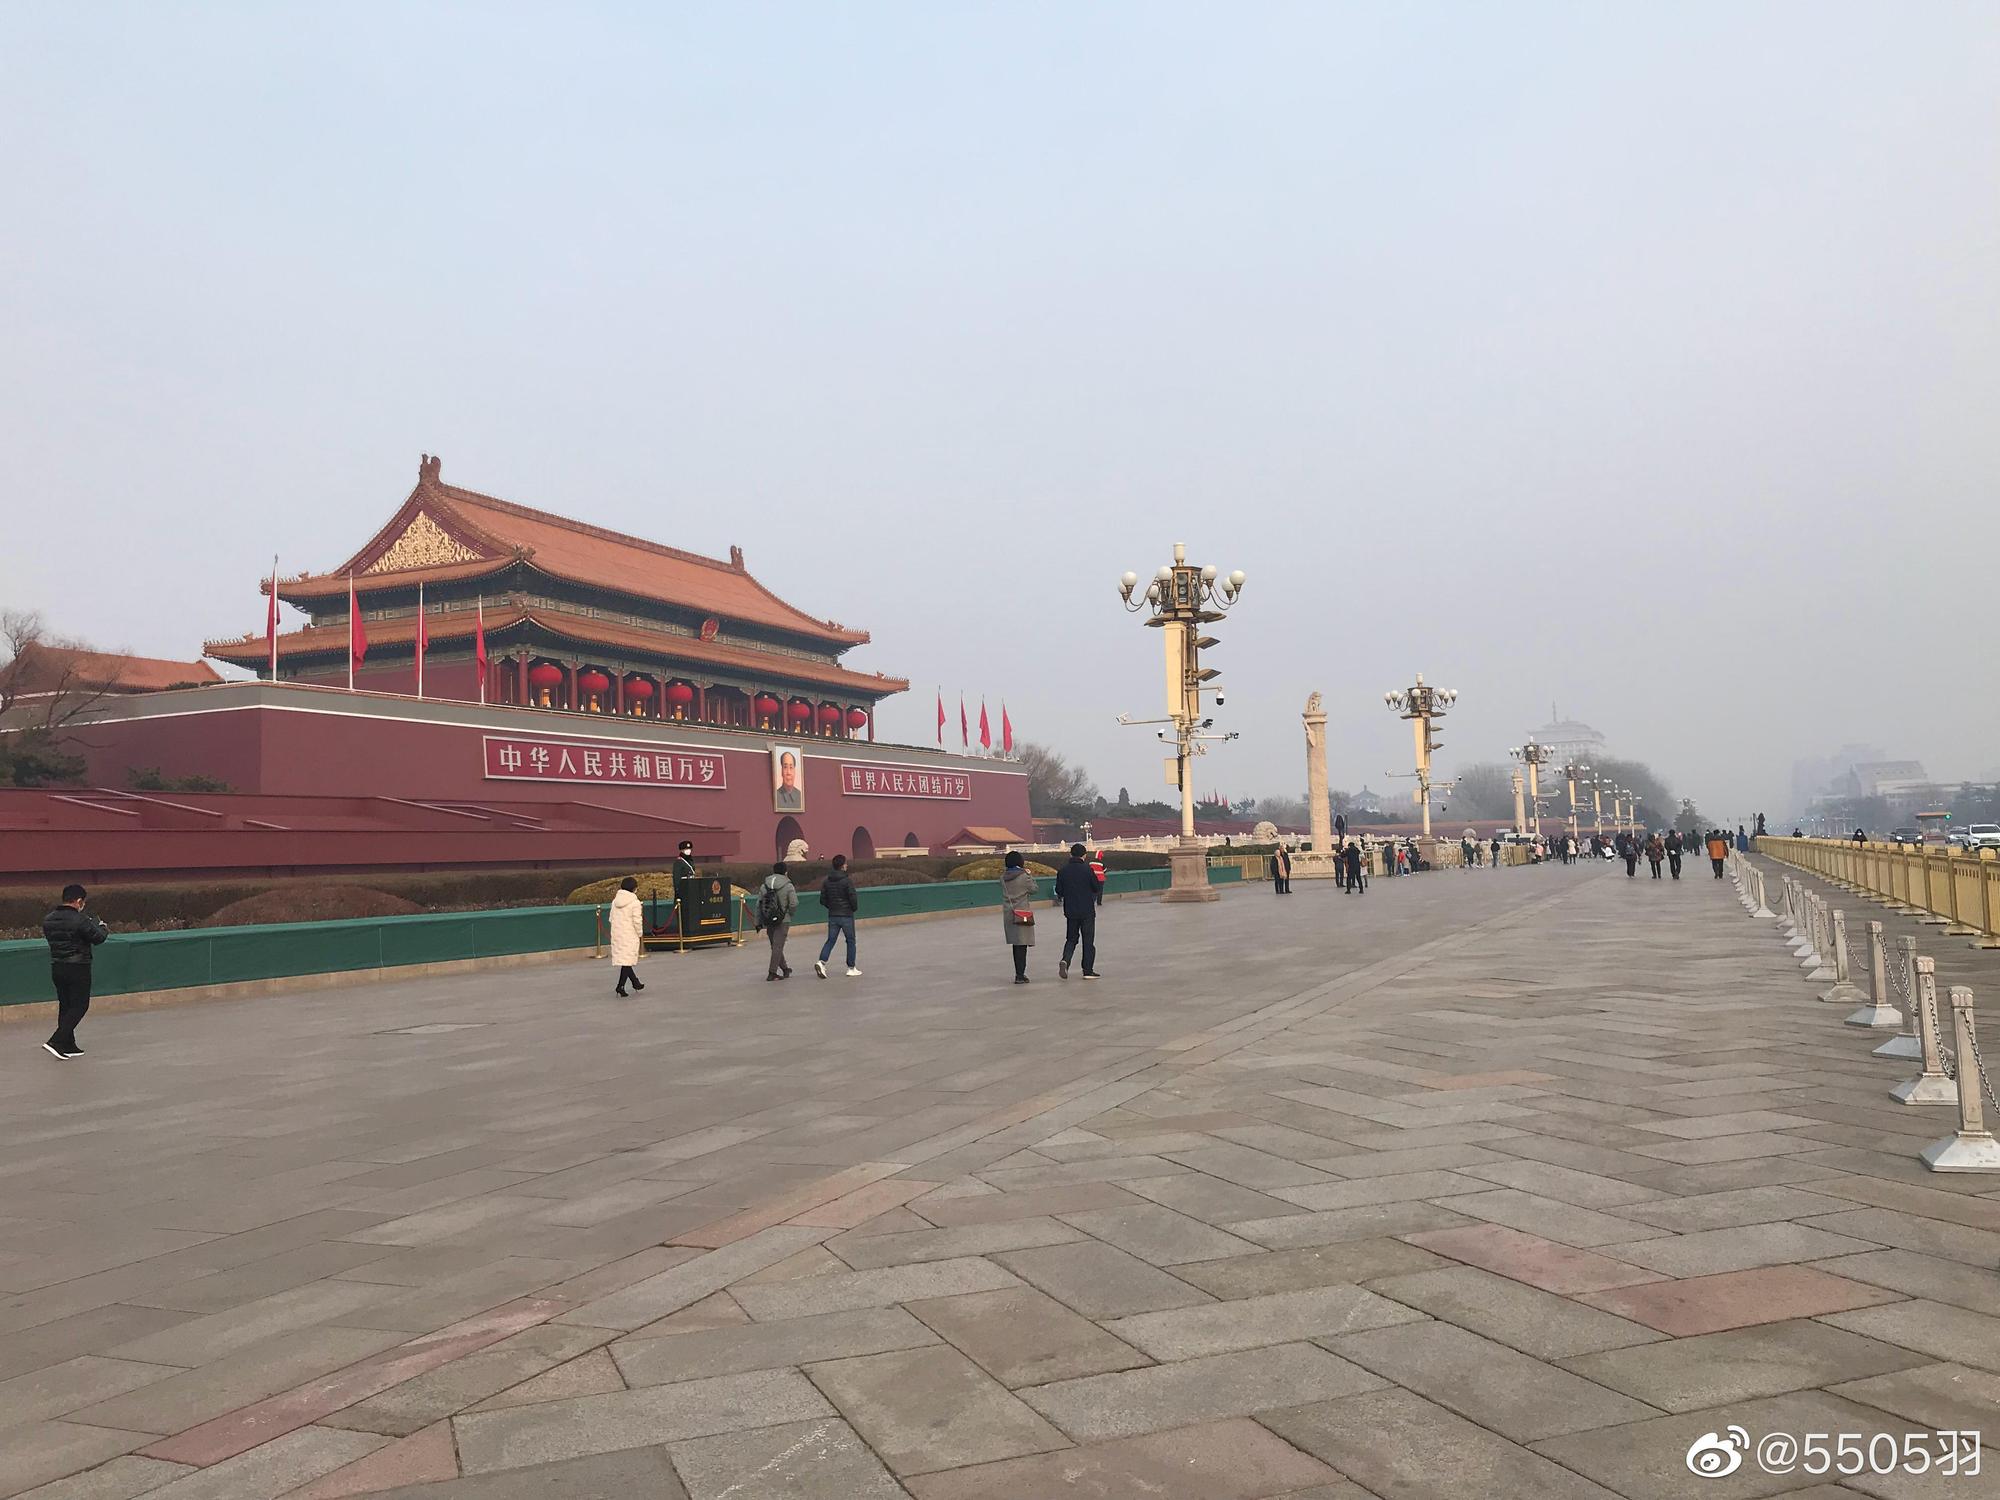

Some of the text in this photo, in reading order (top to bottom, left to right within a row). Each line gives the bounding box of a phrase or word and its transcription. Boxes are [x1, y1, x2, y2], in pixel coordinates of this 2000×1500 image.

[499, 744, 715, 783] 中华人民共和国万岁
[850, 769, 965, 795] 世界人民大团结万岁
